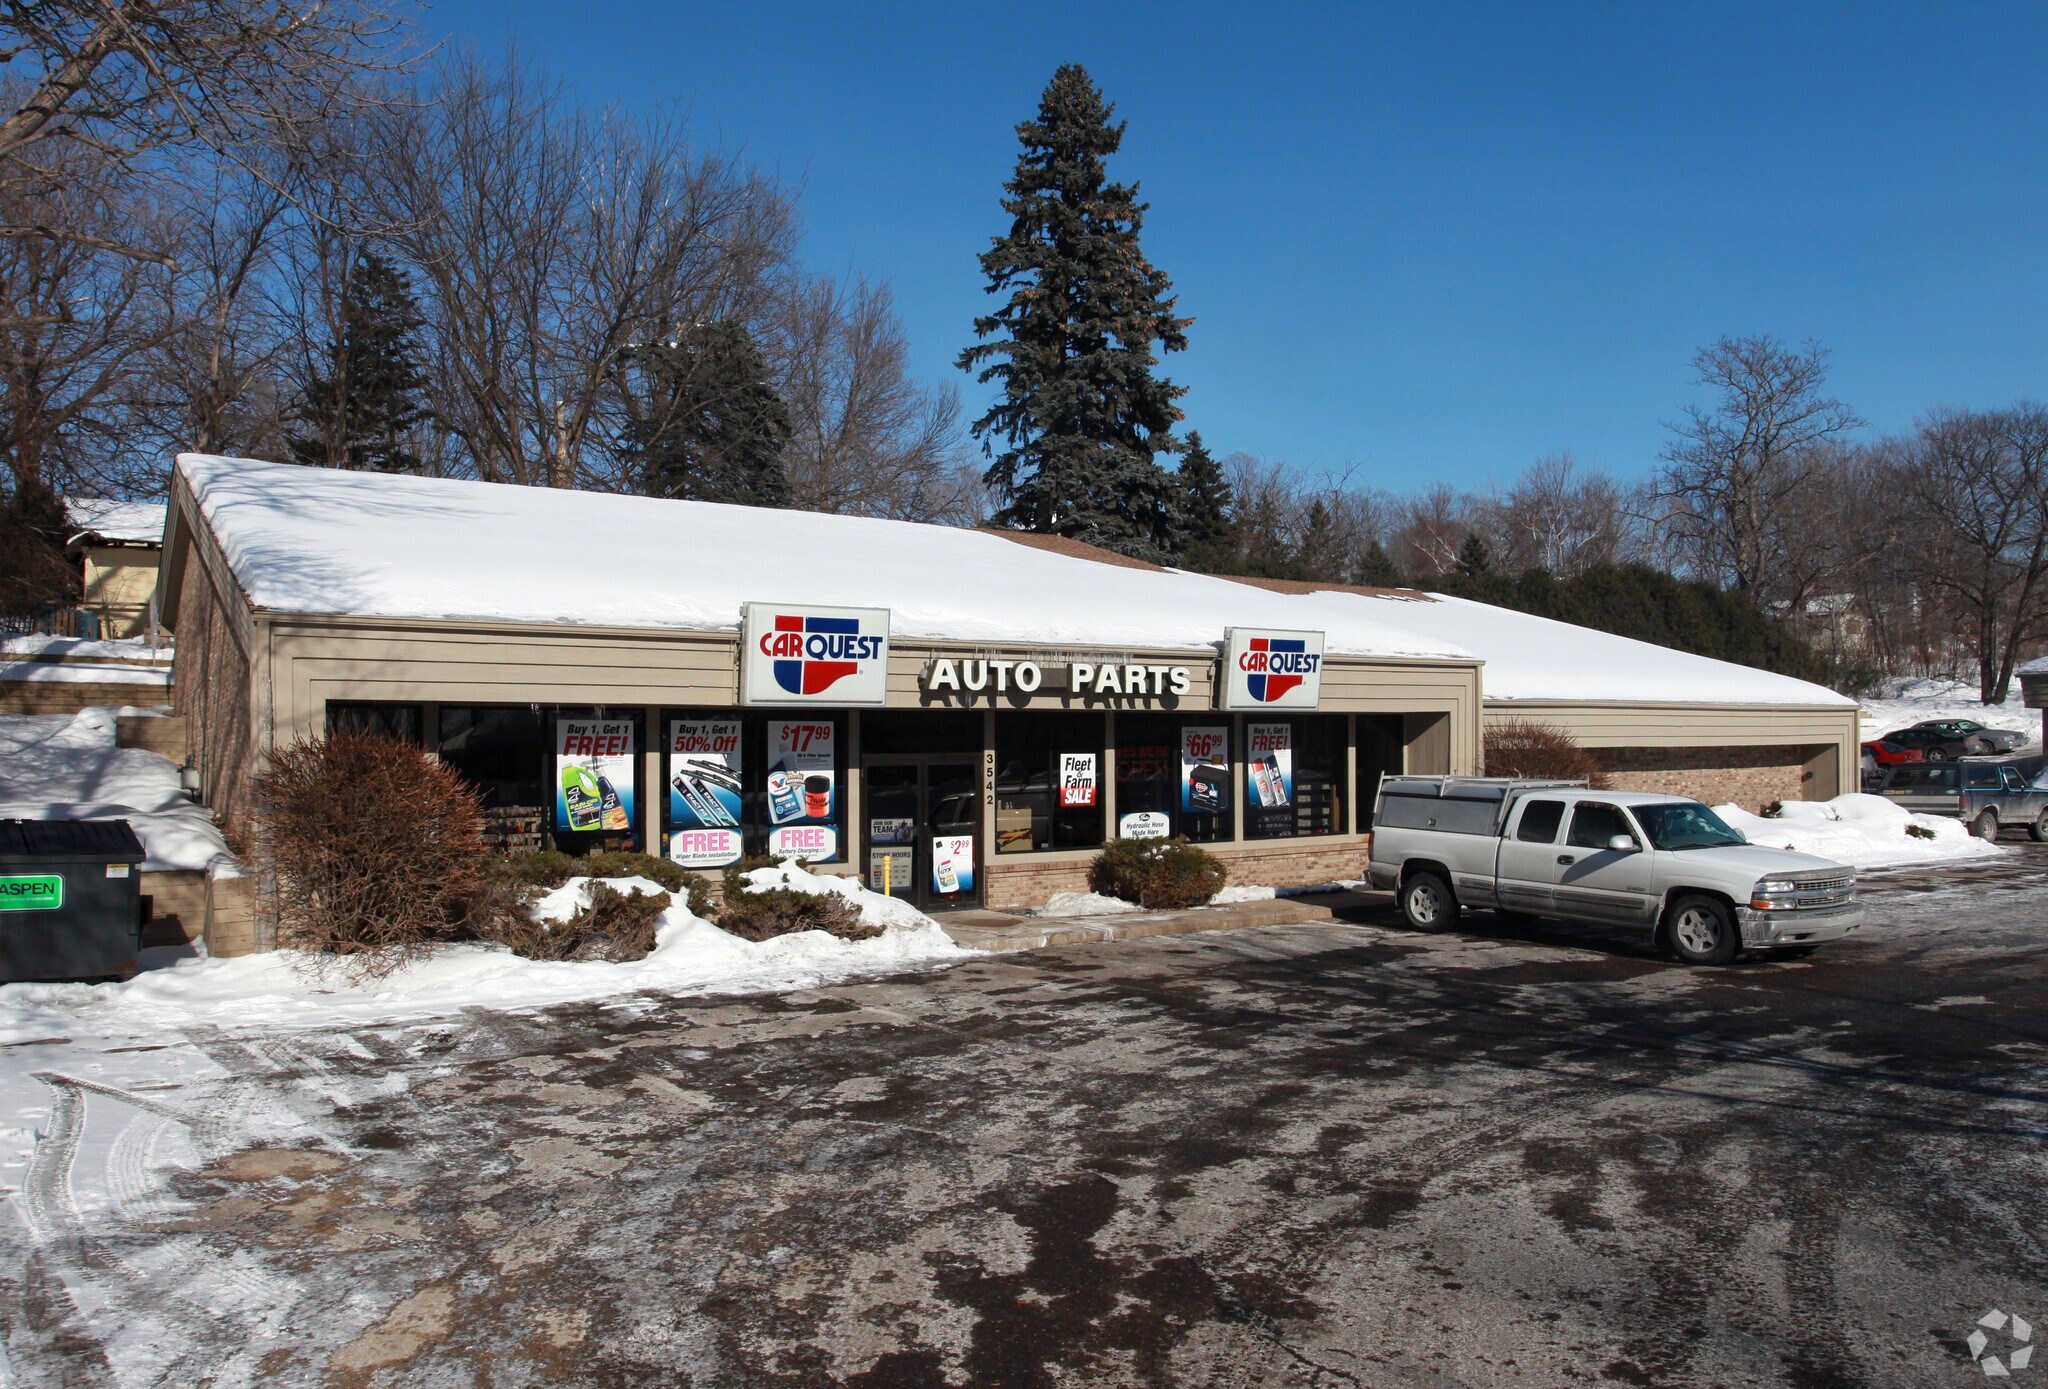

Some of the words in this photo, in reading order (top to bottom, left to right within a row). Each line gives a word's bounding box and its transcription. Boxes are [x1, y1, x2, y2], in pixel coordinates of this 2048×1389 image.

[760, 632, 883, 660] CARQUEST
[1239, 651, 1320, 674] CARQUEST
[928, 659, 1042, 692] AUTO
[1072, 663, 1191, 695] PARTS
[567, 724, 588, 736] Buy
[603, 724, 621, 734] Get
[624, 725, 629, 734] 1
[679, 724, 698, 736] Buy
[712, 725, 728, 734] Get
[731, 725, 736, 734] 1
[1253, 726, 1265, 736] Buy
[1273, 727, 1284, 735] Get
[563, 736, 629, 756] FREE!
[675, 736, 710, 752] 50%
[713, 736, 738, 752] Off
[1251, 735, 1289, 751] FREE!
[1065, 757, 1091, 771] Fleet
[1065, 775, 1092, 789] Farm
[1064, 788, 1092, 804] SALE
[873, 826, 894, 834] TEAM
[1126, 822, 1151, 830] Hydraulic
[682, 832, 730, 852] FREE
[781, 829, 825, 848] FREE
[891, 851, 911, 859] HOURS
[0, 883, 55, 895] ASPEN
